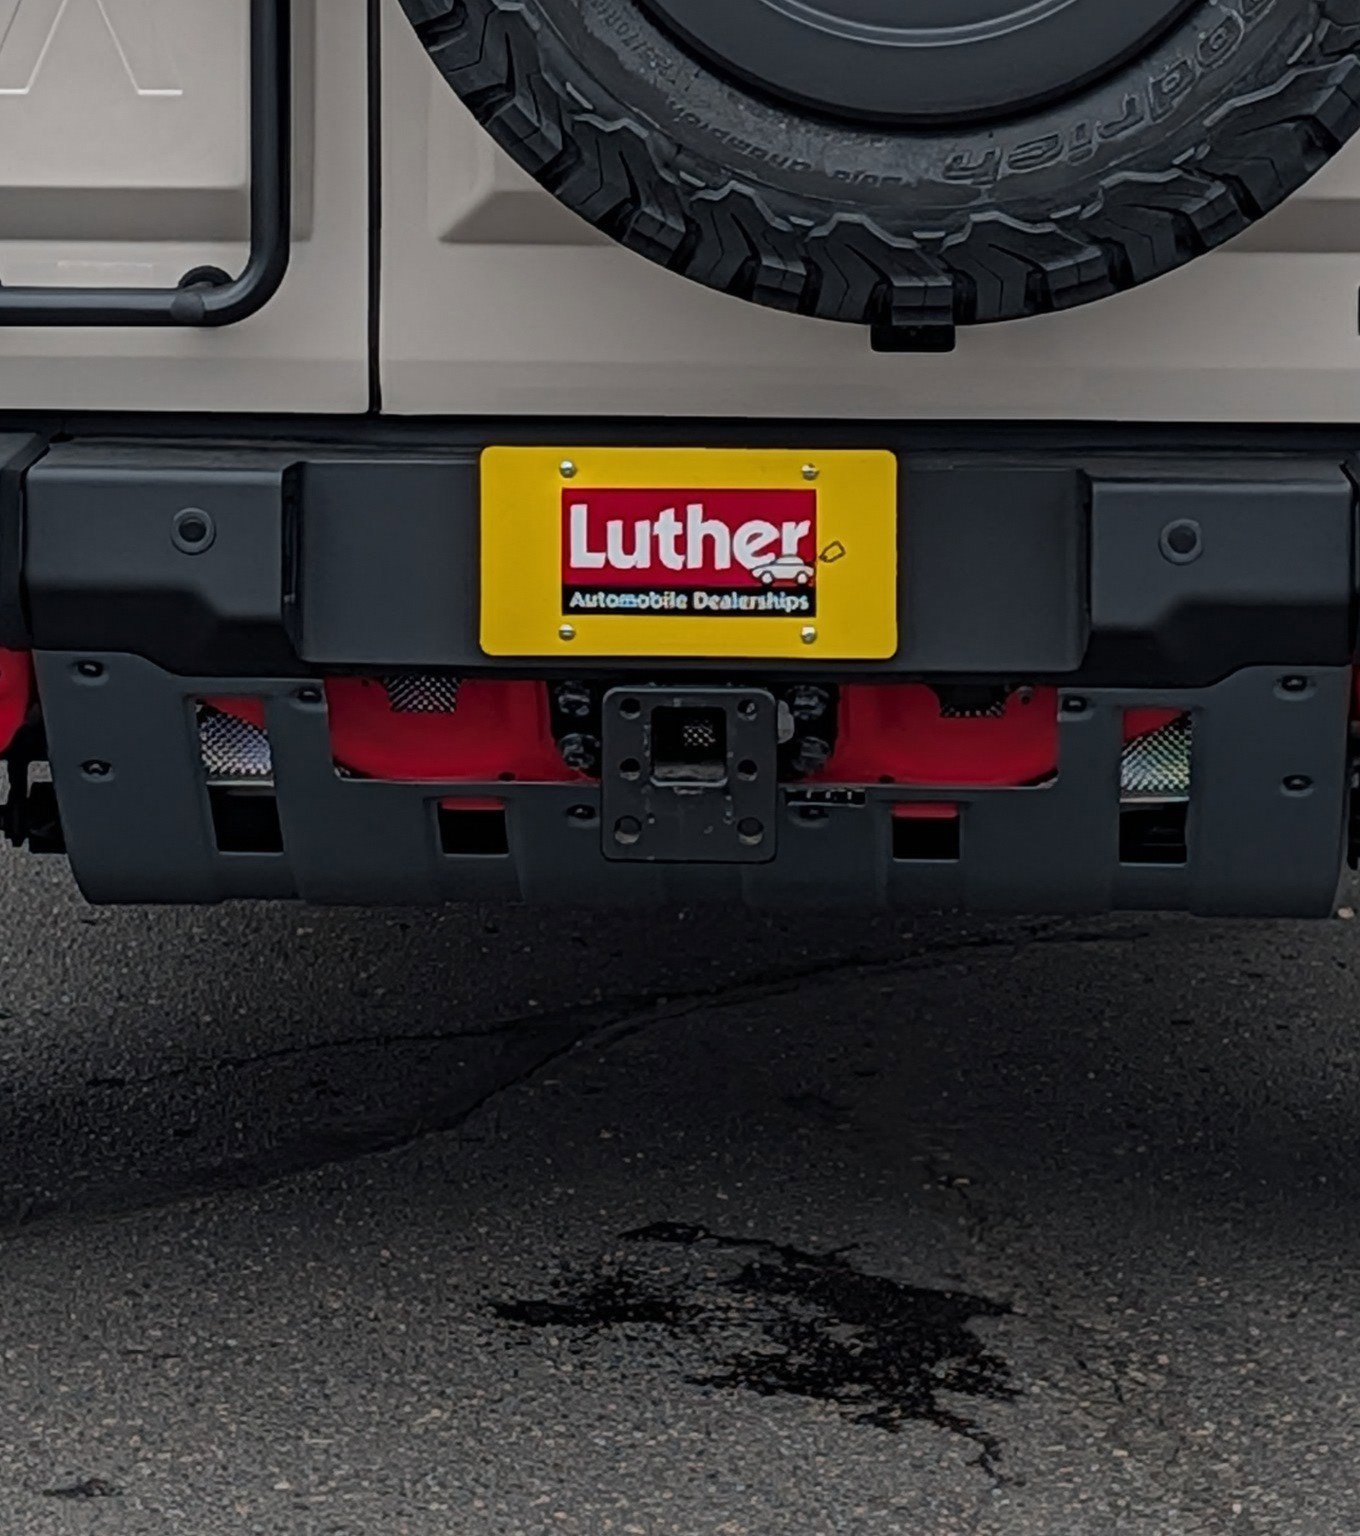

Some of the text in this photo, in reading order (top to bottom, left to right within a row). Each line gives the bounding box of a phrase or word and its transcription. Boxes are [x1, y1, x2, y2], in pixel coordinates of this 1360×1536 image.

[569, 502, 812, 571] Luther
[568, 590, 810, 614] Automobile Dealerships
